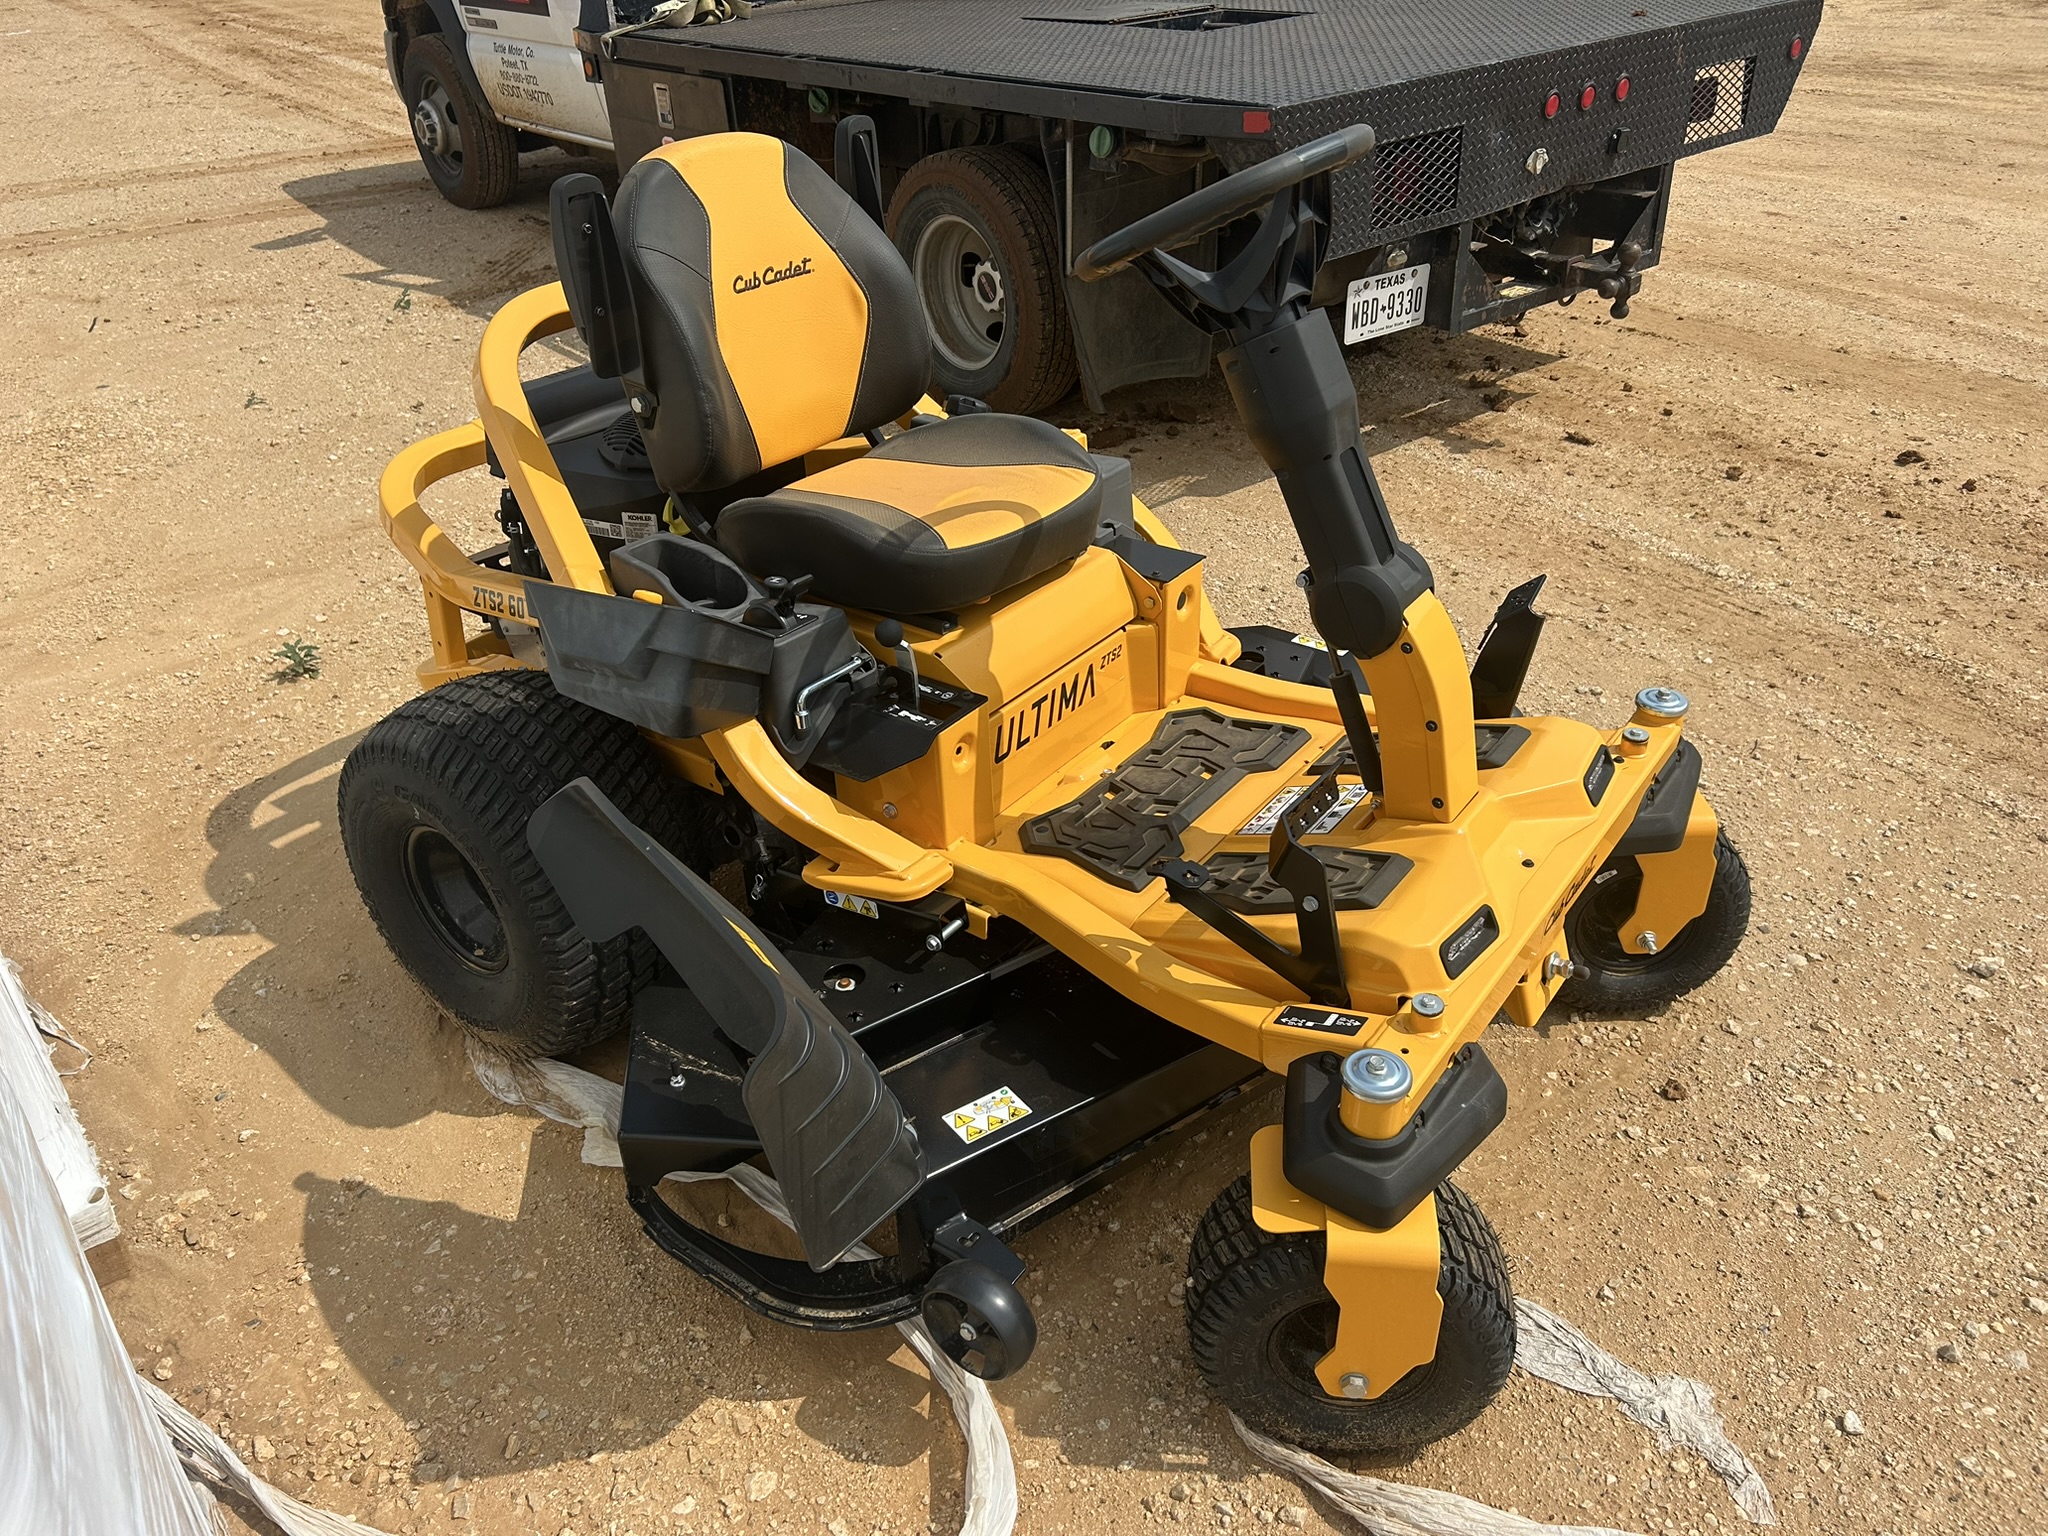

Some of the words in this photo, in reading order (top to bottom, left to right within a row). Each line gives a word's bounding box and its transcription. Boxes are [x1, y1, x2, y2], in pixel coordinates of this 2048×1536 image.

[526, 46, 535, 58] Co.
[520, 60, 529, 71] TX
[497, 82, 523, 99] USDOT
[732, 271, 761, 295] Cub
[762, 257, 812, 286] Cadet
[1375, 273, 1406, 290] TEXAS
[627, 514, 653, 522] KOHLER
[472, 586, 504, 614] ZTS2
[1099, 644, 1123, 670] ZTS2
[993, 662, 1097, 765] ULTIMA
